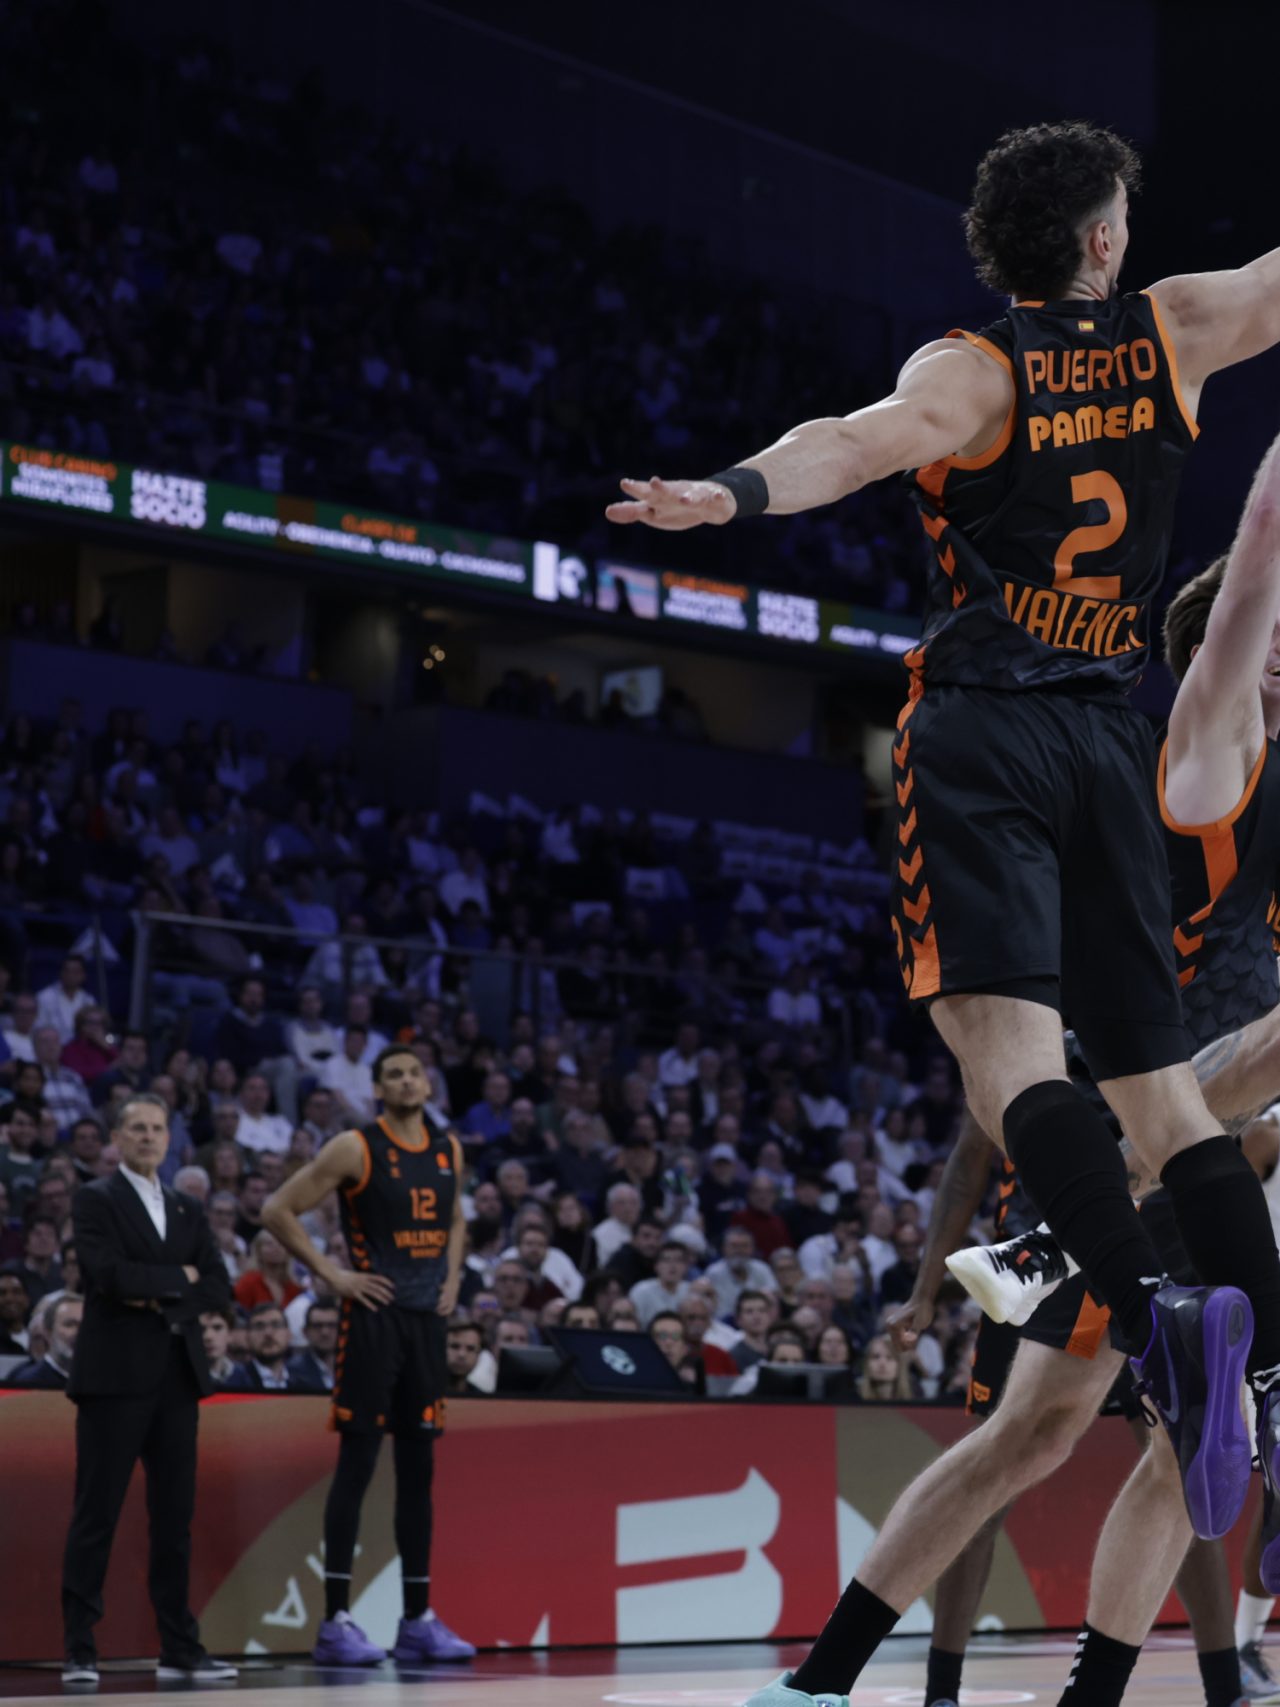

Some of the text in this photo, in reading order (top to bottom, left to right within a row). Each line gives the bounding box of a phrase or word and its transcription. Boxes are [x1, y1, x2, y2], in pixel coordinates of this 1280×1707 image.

[1024, 338, 1157, 394] PUERTO
[1028, 397, 1155, 452] PAMEA
[1051, 470, 1127, 600] 2
[1004, 582, 1145, 657] VALENC
[409, 1187, 437, 1220] 12
